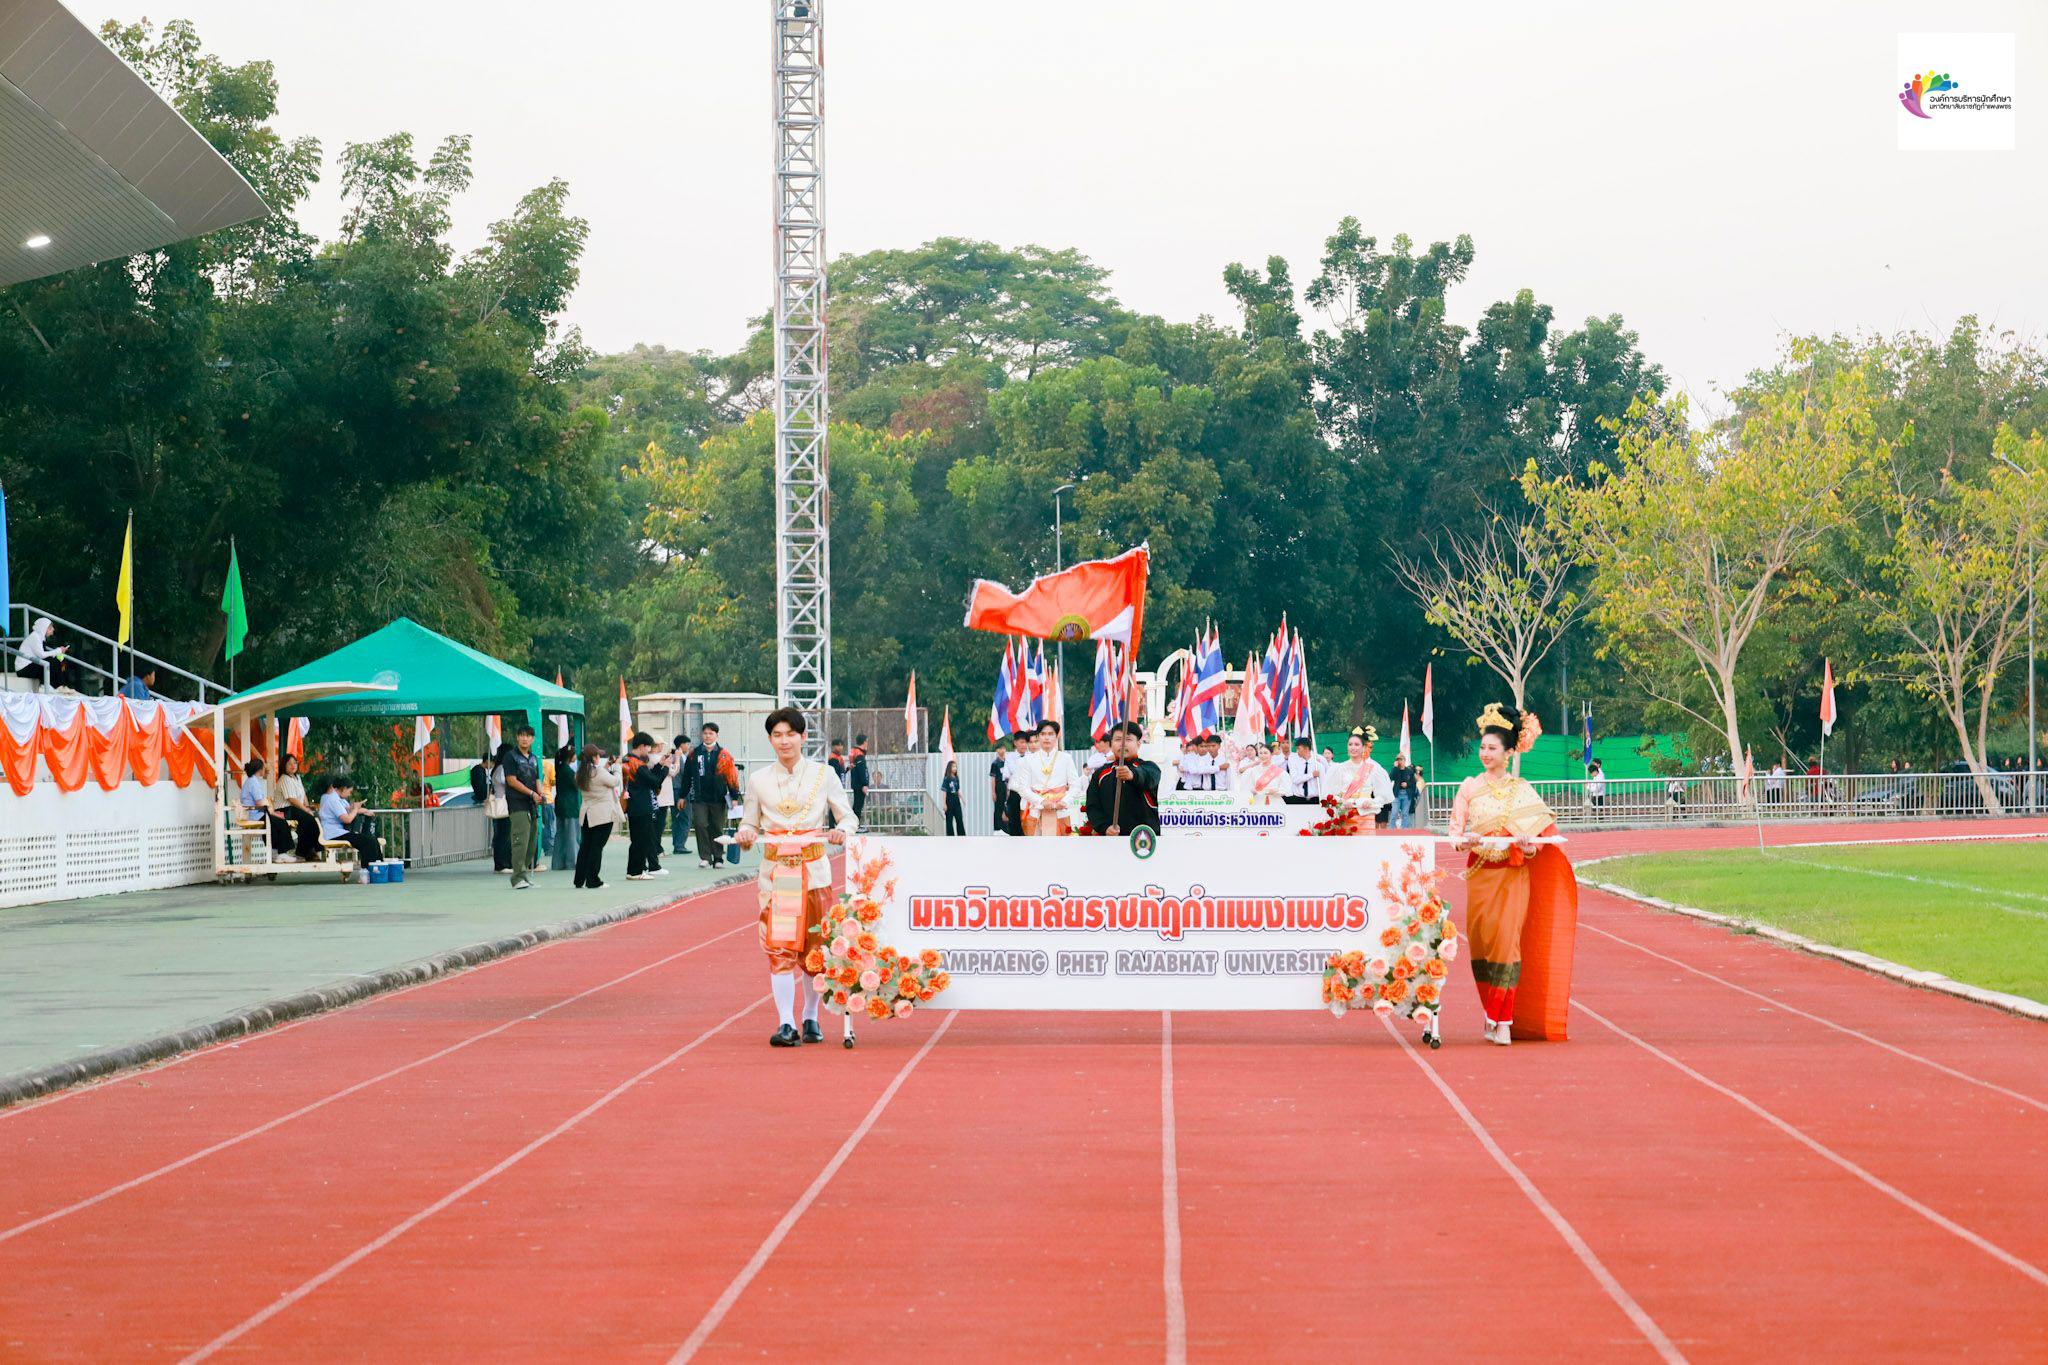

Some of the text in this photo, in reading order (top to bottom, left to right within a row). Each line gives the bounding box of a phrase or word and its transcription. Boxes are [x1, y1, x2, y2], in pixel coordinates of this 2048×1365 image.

[911, 886, 1366, 938] มหาวิทยาลัยราชภัฏกำแพงเพชร
[1058, 952, 1107, 974] PHET
[1117, 952, 1218, 974] RAJABHAT
